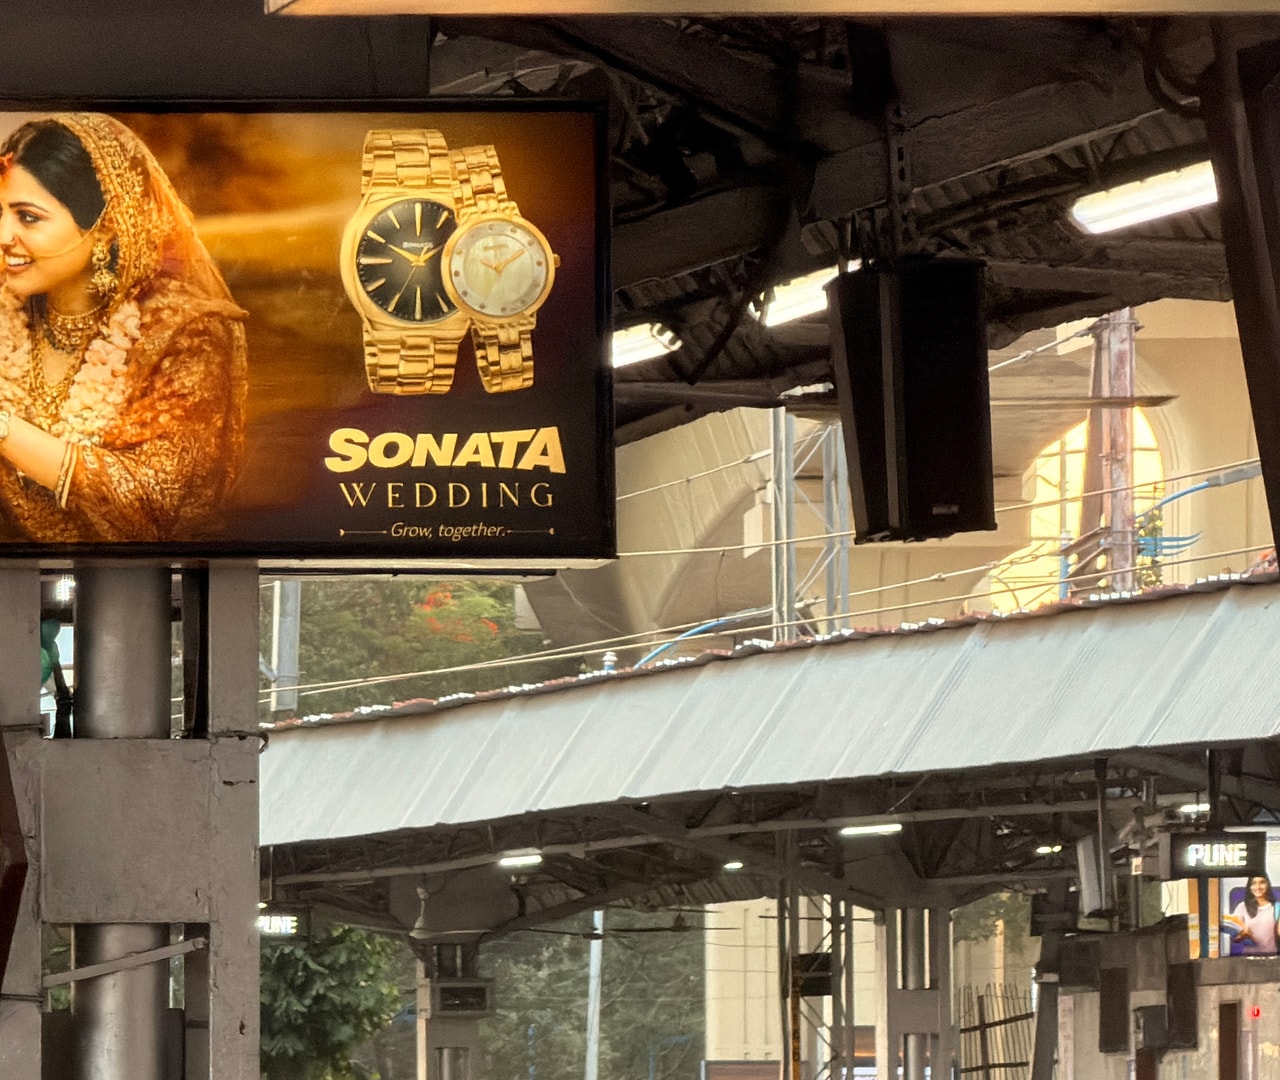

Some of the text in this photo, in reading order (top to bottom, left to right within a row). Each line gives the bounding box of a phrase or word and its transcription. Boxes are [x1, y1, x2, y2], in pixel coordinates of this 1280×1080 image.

[325, 426, 566, 474] SONATA
[340, 482, 553, 508] WEDDING
[391, 522, 506, 542] Grow, together.
[1188, 843, 1247, 867] PUNE
